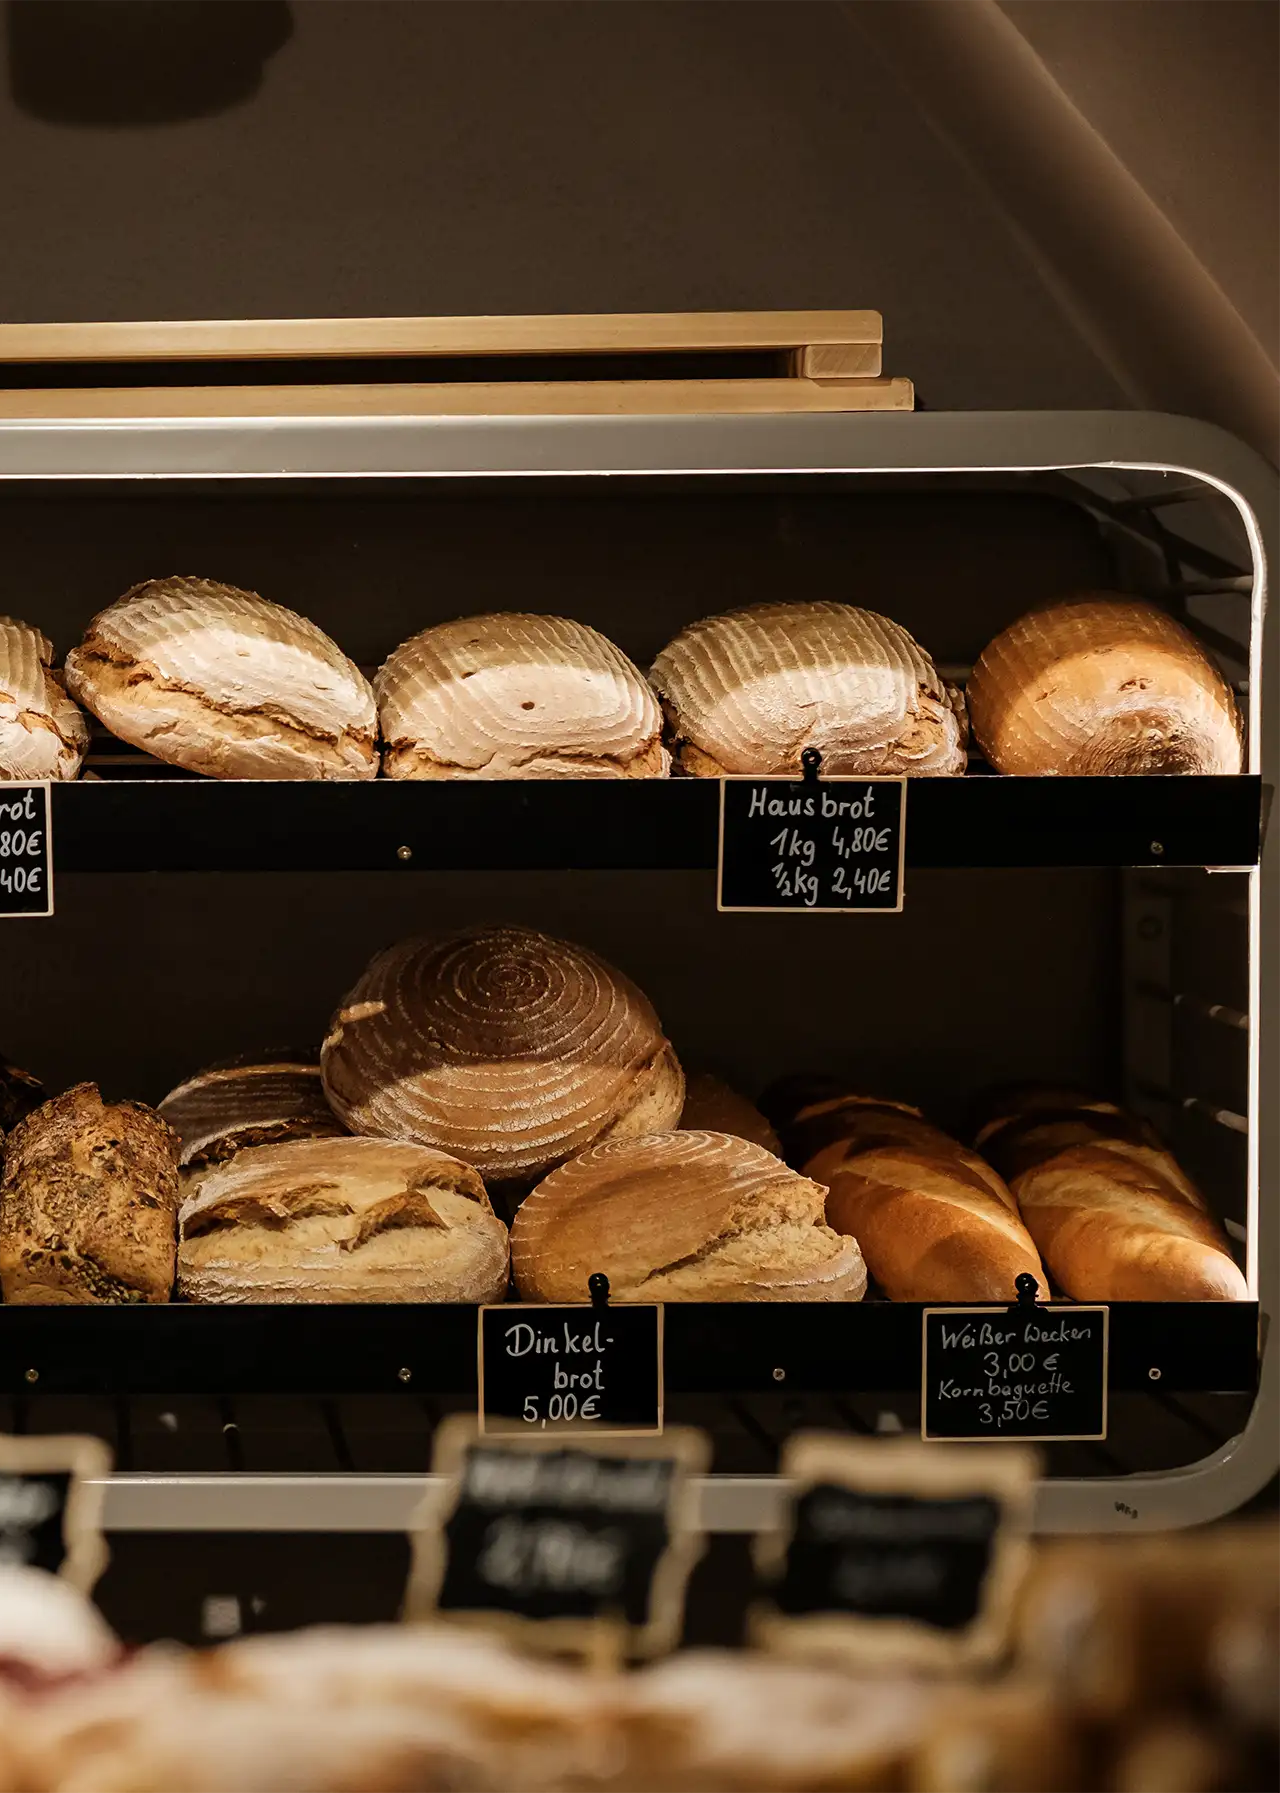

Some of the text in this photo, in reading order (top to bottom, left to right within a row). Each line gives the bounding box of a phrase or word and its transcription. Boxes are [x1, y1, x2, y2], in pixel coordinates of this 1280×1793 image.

[770, 826, 891, 866] 1kg 4,80€
[831, 867, 891, 900] 2,40€
[505, 1321, 614, 1356] Dinkel-
[941, 1320, 1091, 1349] Weißer Wecken
[554, 1360, 605, 1390] brot
[523, 1393, 601, 1429] 5,00€
[978, 1400, 1050, 1427] 3,50€
